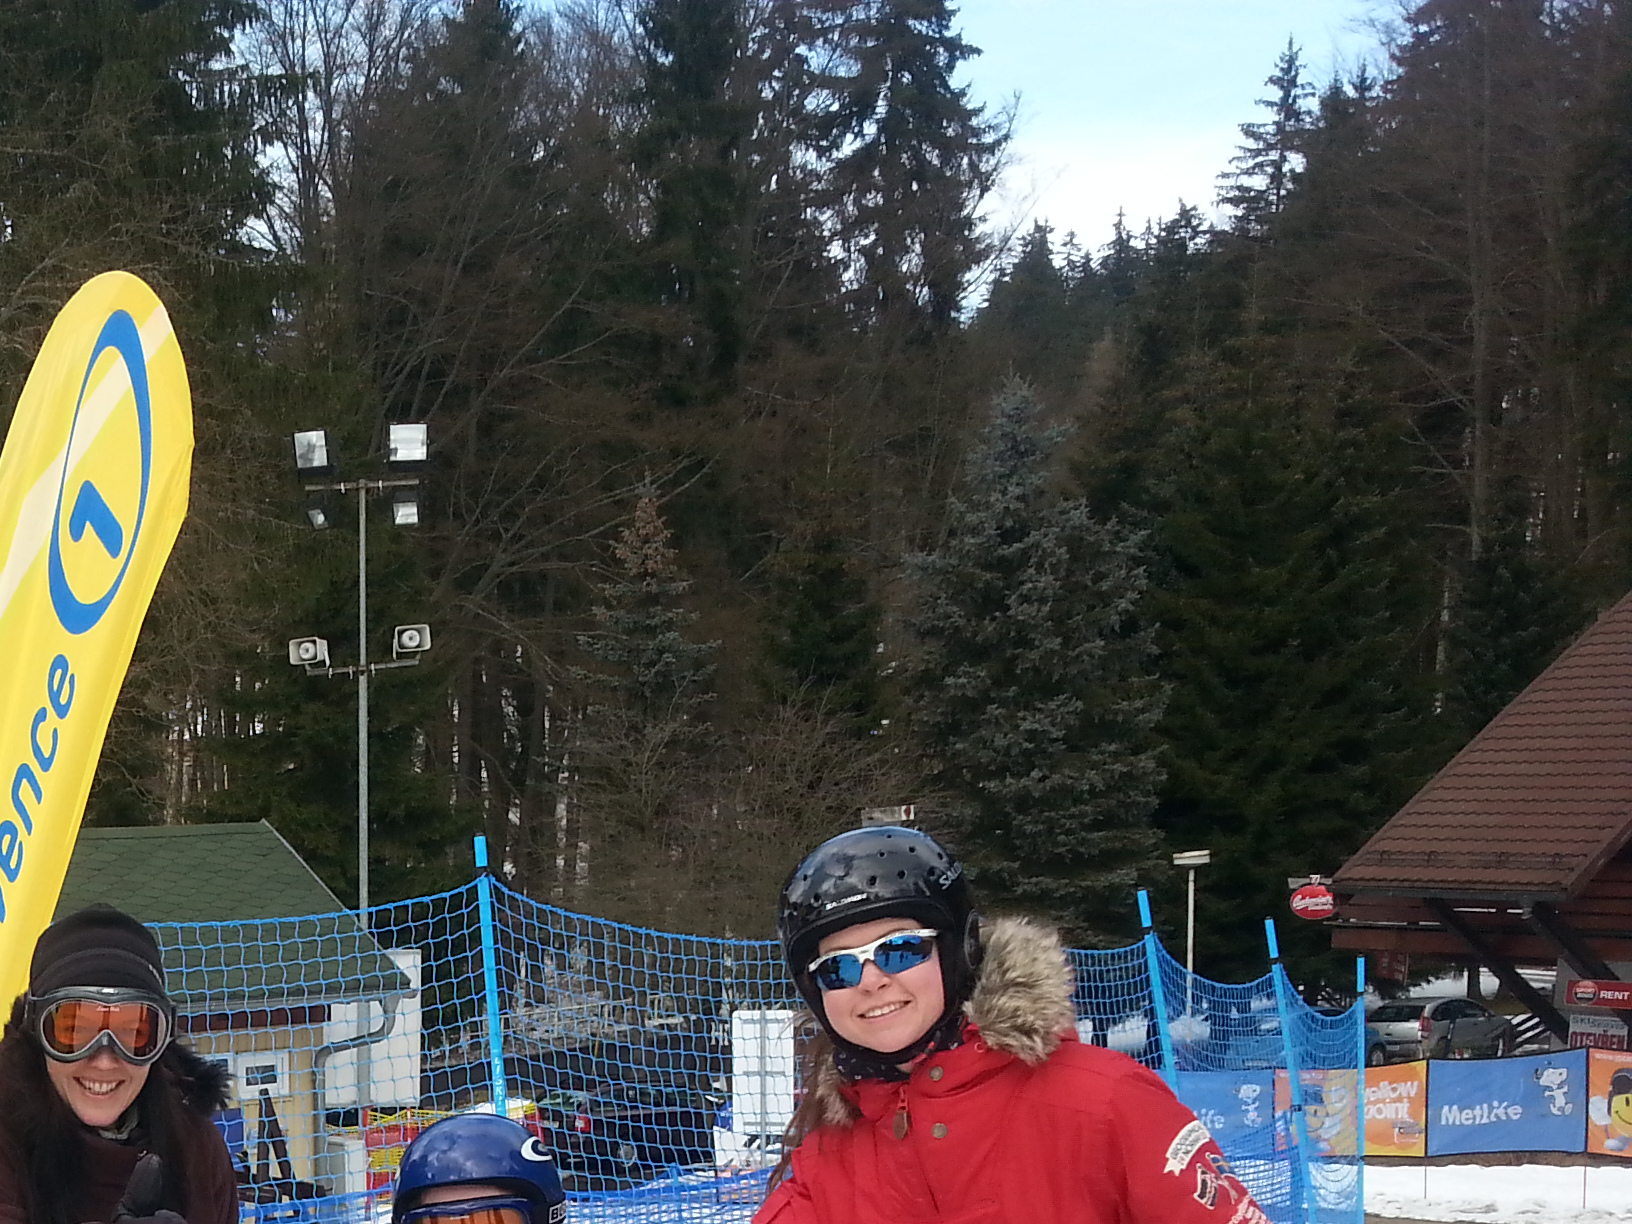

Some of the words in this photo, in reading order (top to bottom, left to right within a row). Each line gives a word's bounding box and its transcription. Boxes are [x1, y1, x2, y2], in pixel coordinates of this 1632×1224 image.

[825, 893, 868, 911] SALOMON
[1599, 990, 1630, 1000] RENT
[1441, 1100, 1523, 1125] MetLife
